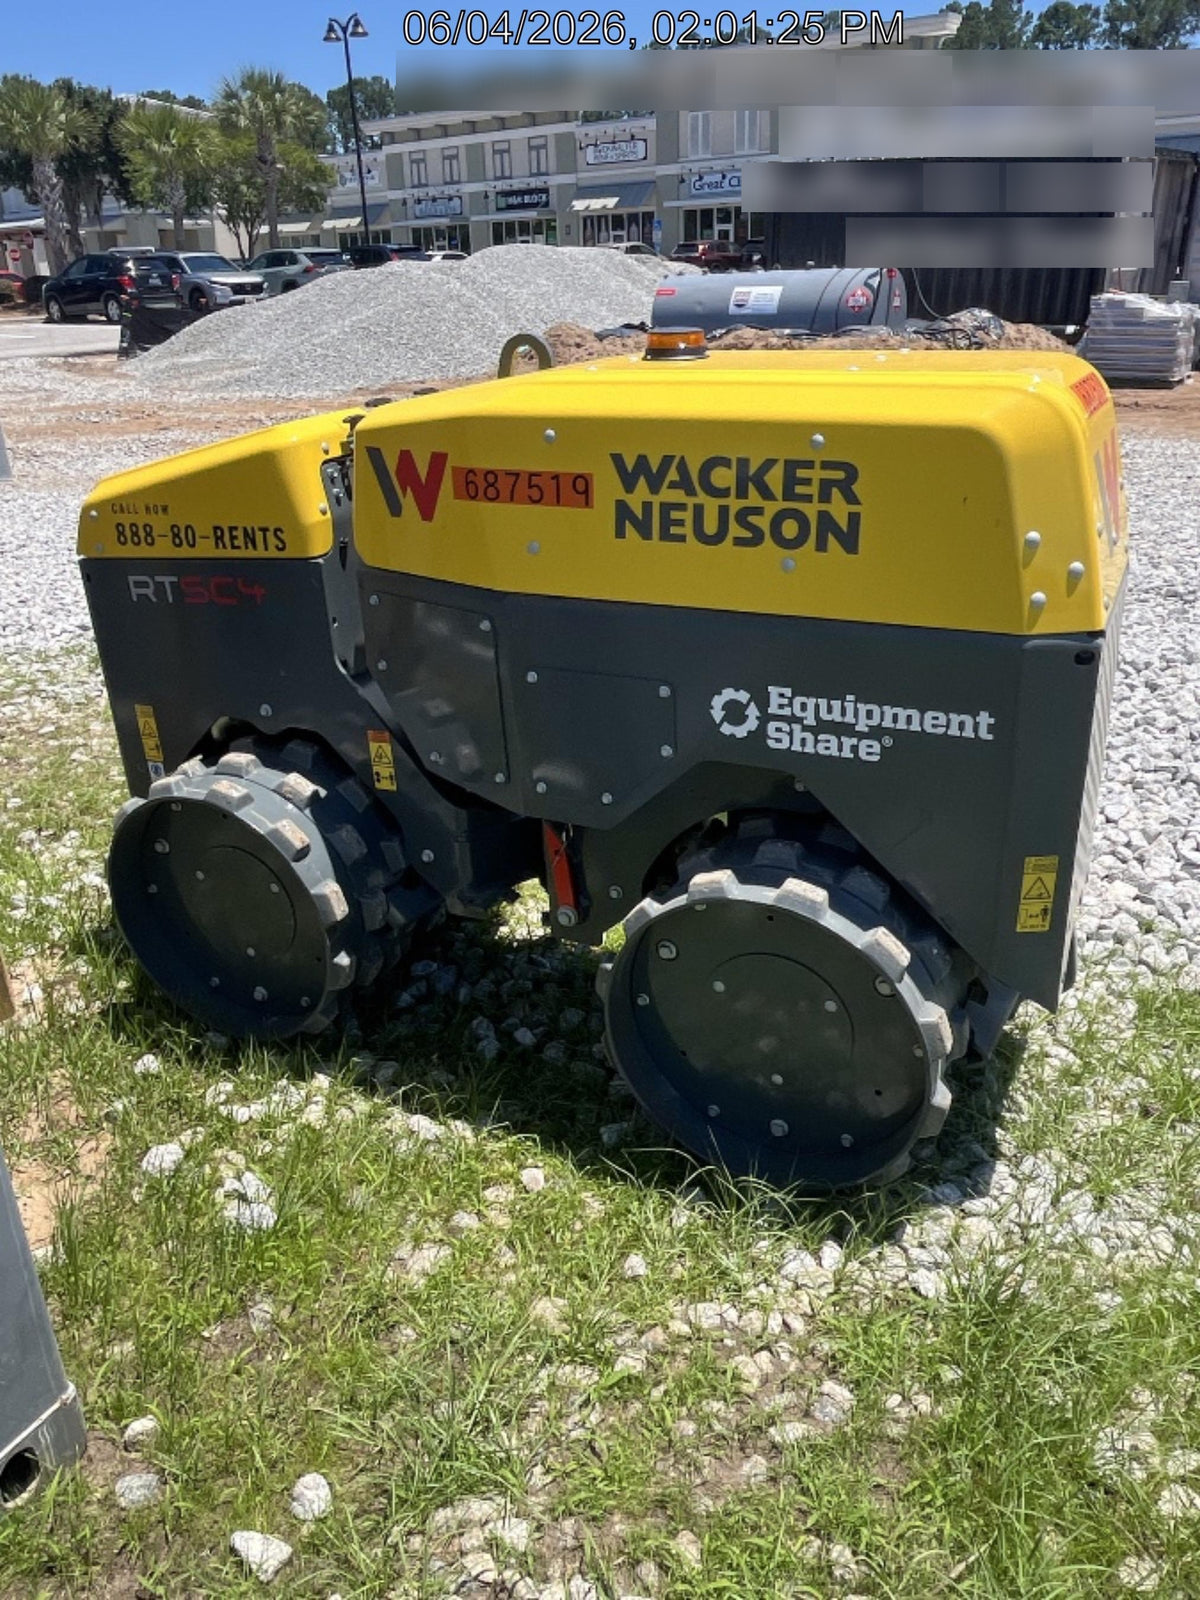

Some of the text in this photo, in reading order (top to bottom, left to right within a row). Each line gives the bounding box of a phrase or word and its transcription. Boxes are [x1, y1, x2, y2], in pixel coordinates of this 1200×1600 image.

[693, 178, 724, 191] Great
[464, 469, 590, 506] 687519
[609, 453, 863, 505] WACKER
[111, 503, 169, 516] CALL NOW
[115, 522, 287, 552] 888-80-RENTS
[614, 499, 862, 555] NEUSON
[127, 575, 267, 604] RTSC4
[767, 685, 996, 741] Equipment
